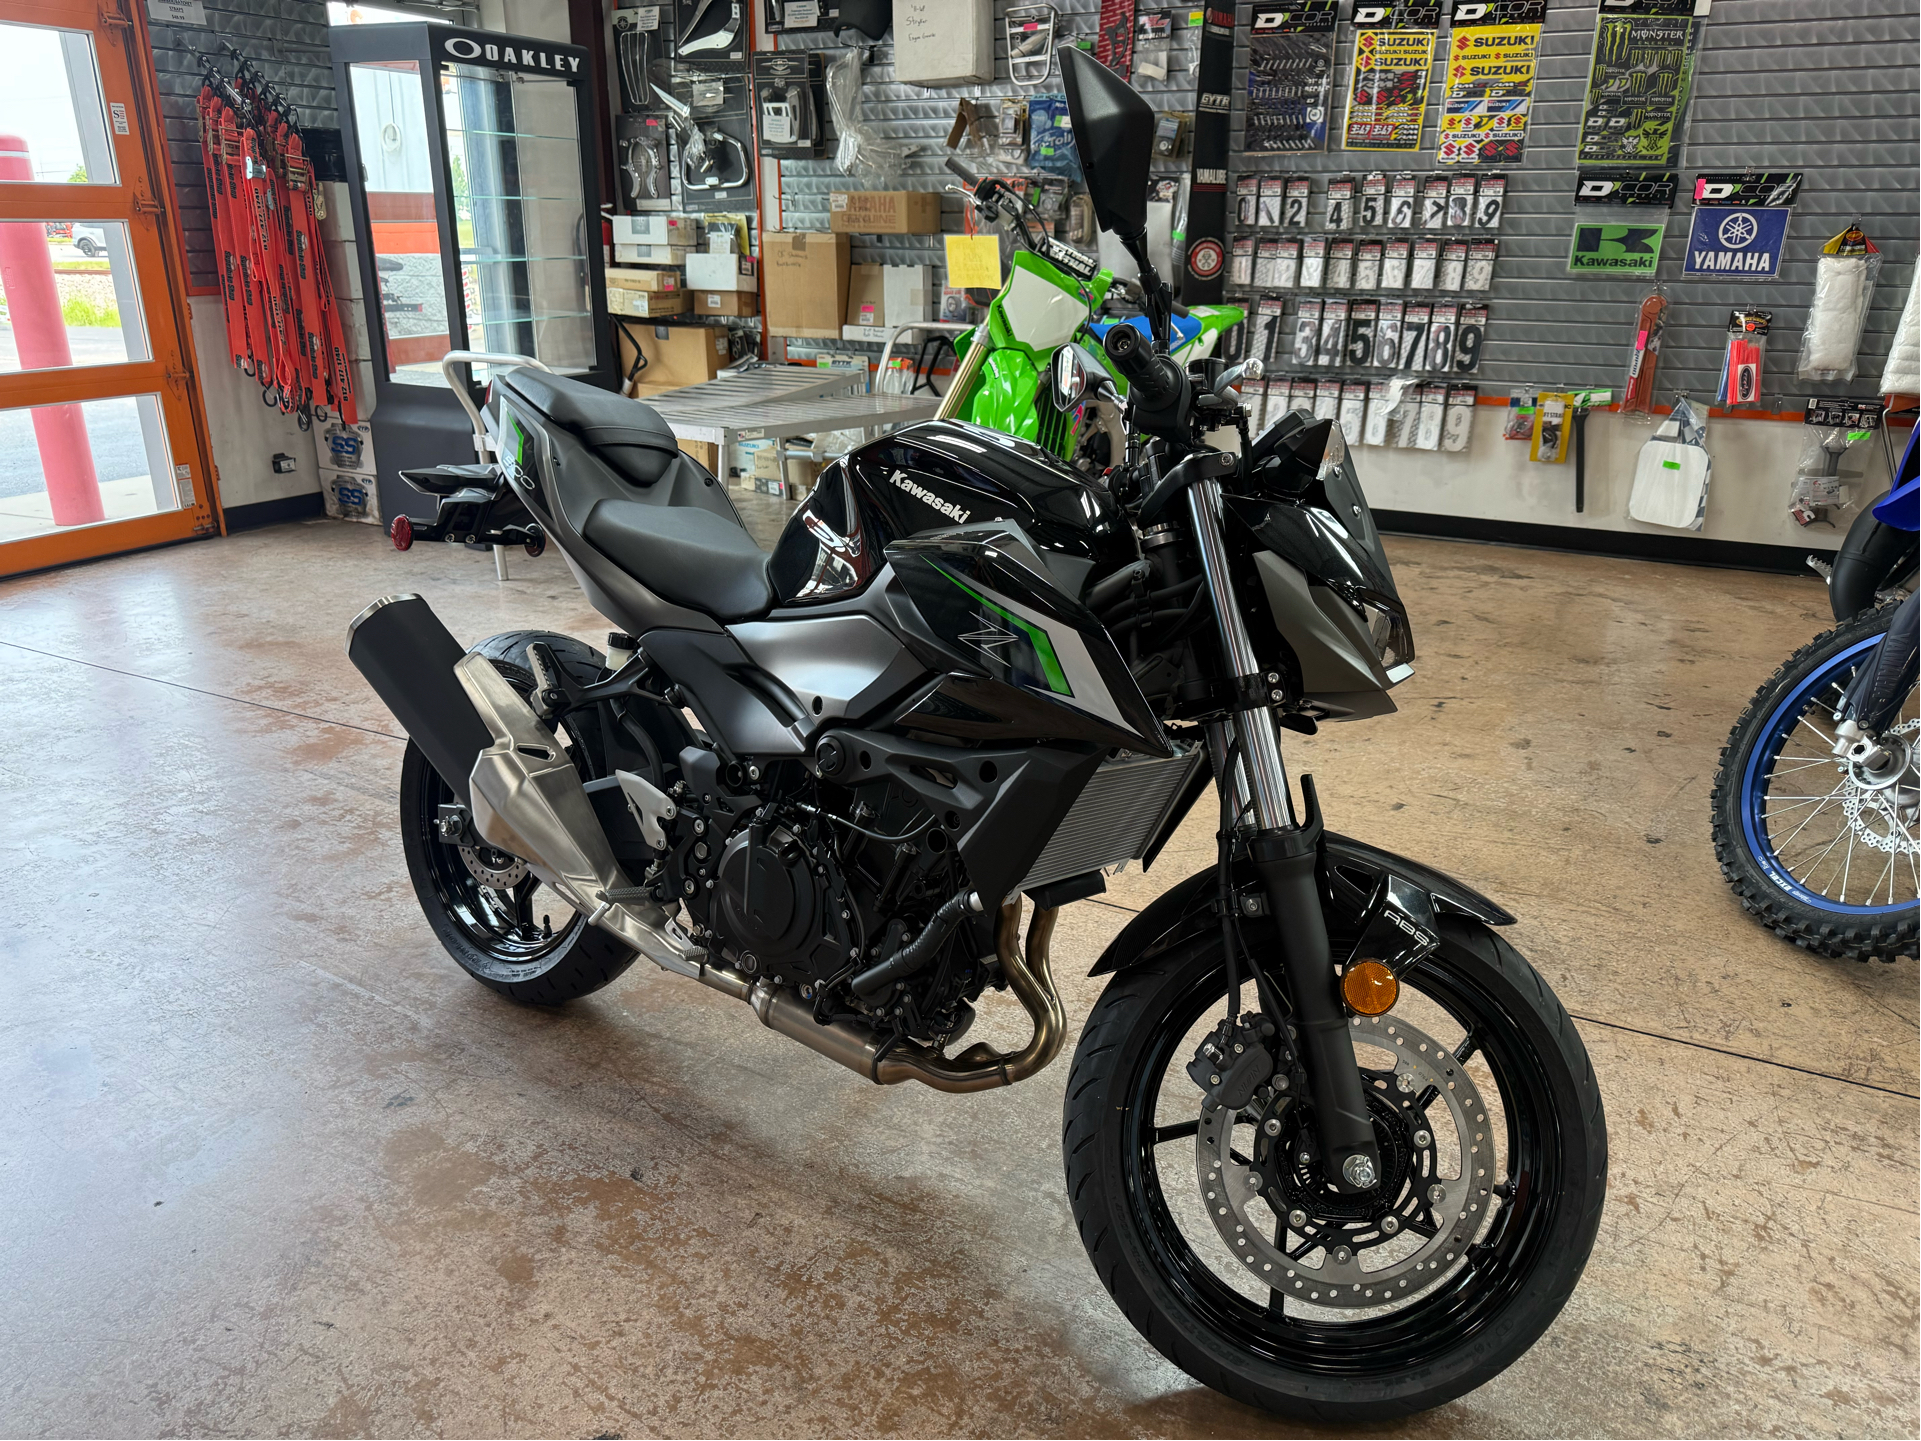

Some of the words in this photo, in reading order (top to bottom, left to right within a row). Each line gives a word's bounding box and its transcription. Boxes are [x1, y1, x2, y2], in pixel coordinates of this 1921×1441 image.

[1377, 38, 1430, 46] SUZUKI
[1473, 36, 1535, 47] SUZUKI
[485, 44, 580, 73] OAKLEY
[1374, 58, 1428, 67] SUZUKI
[1470, 65, 1532, 76] SUZUKI
[1201, 93, 1230, 107] GYTR
[1196, 168, 1227, 184] YAMALUBE
[1288, 199, 1302, 226] 2
[1329, 202, 1343, 229] 4
[1363, 197, 1377, 225] 5
[1451, 197, 1467, 225] 8
[1478, 200, 1500, 227] 9
[1445, 262, 1462, 288] 8
[1469, 261, 1489, 289] 9
[1573, 255, 1654, 268] Kawasaki
[1694, 251, 1770, 271] YAMAHA
[997, 305, 1012, 337] Kawasaki
[1264, 316, 1278, 362] 1
[1294, 321, 1317, 363] 3
[1320, 321, 1341, 365] 4
[1349, 320, 1372, 366] 5
[1376, 322, 1397, 367] 6
[1404, 323, 1426, 369] 7
[1427, 325, 1451, 371] 8
[1457, 325, 1482, 372] 9
[334, 347, 349, 402] 812-477-1740
[1420, 405, 1443, 449] 8
[1445, 406, 1471, 452] 9
[889, 469, 970, 524] Kawasaki
[1769, 871, 1792, 891] EXCEL
[1384, 910, 1429, 945] ABS
